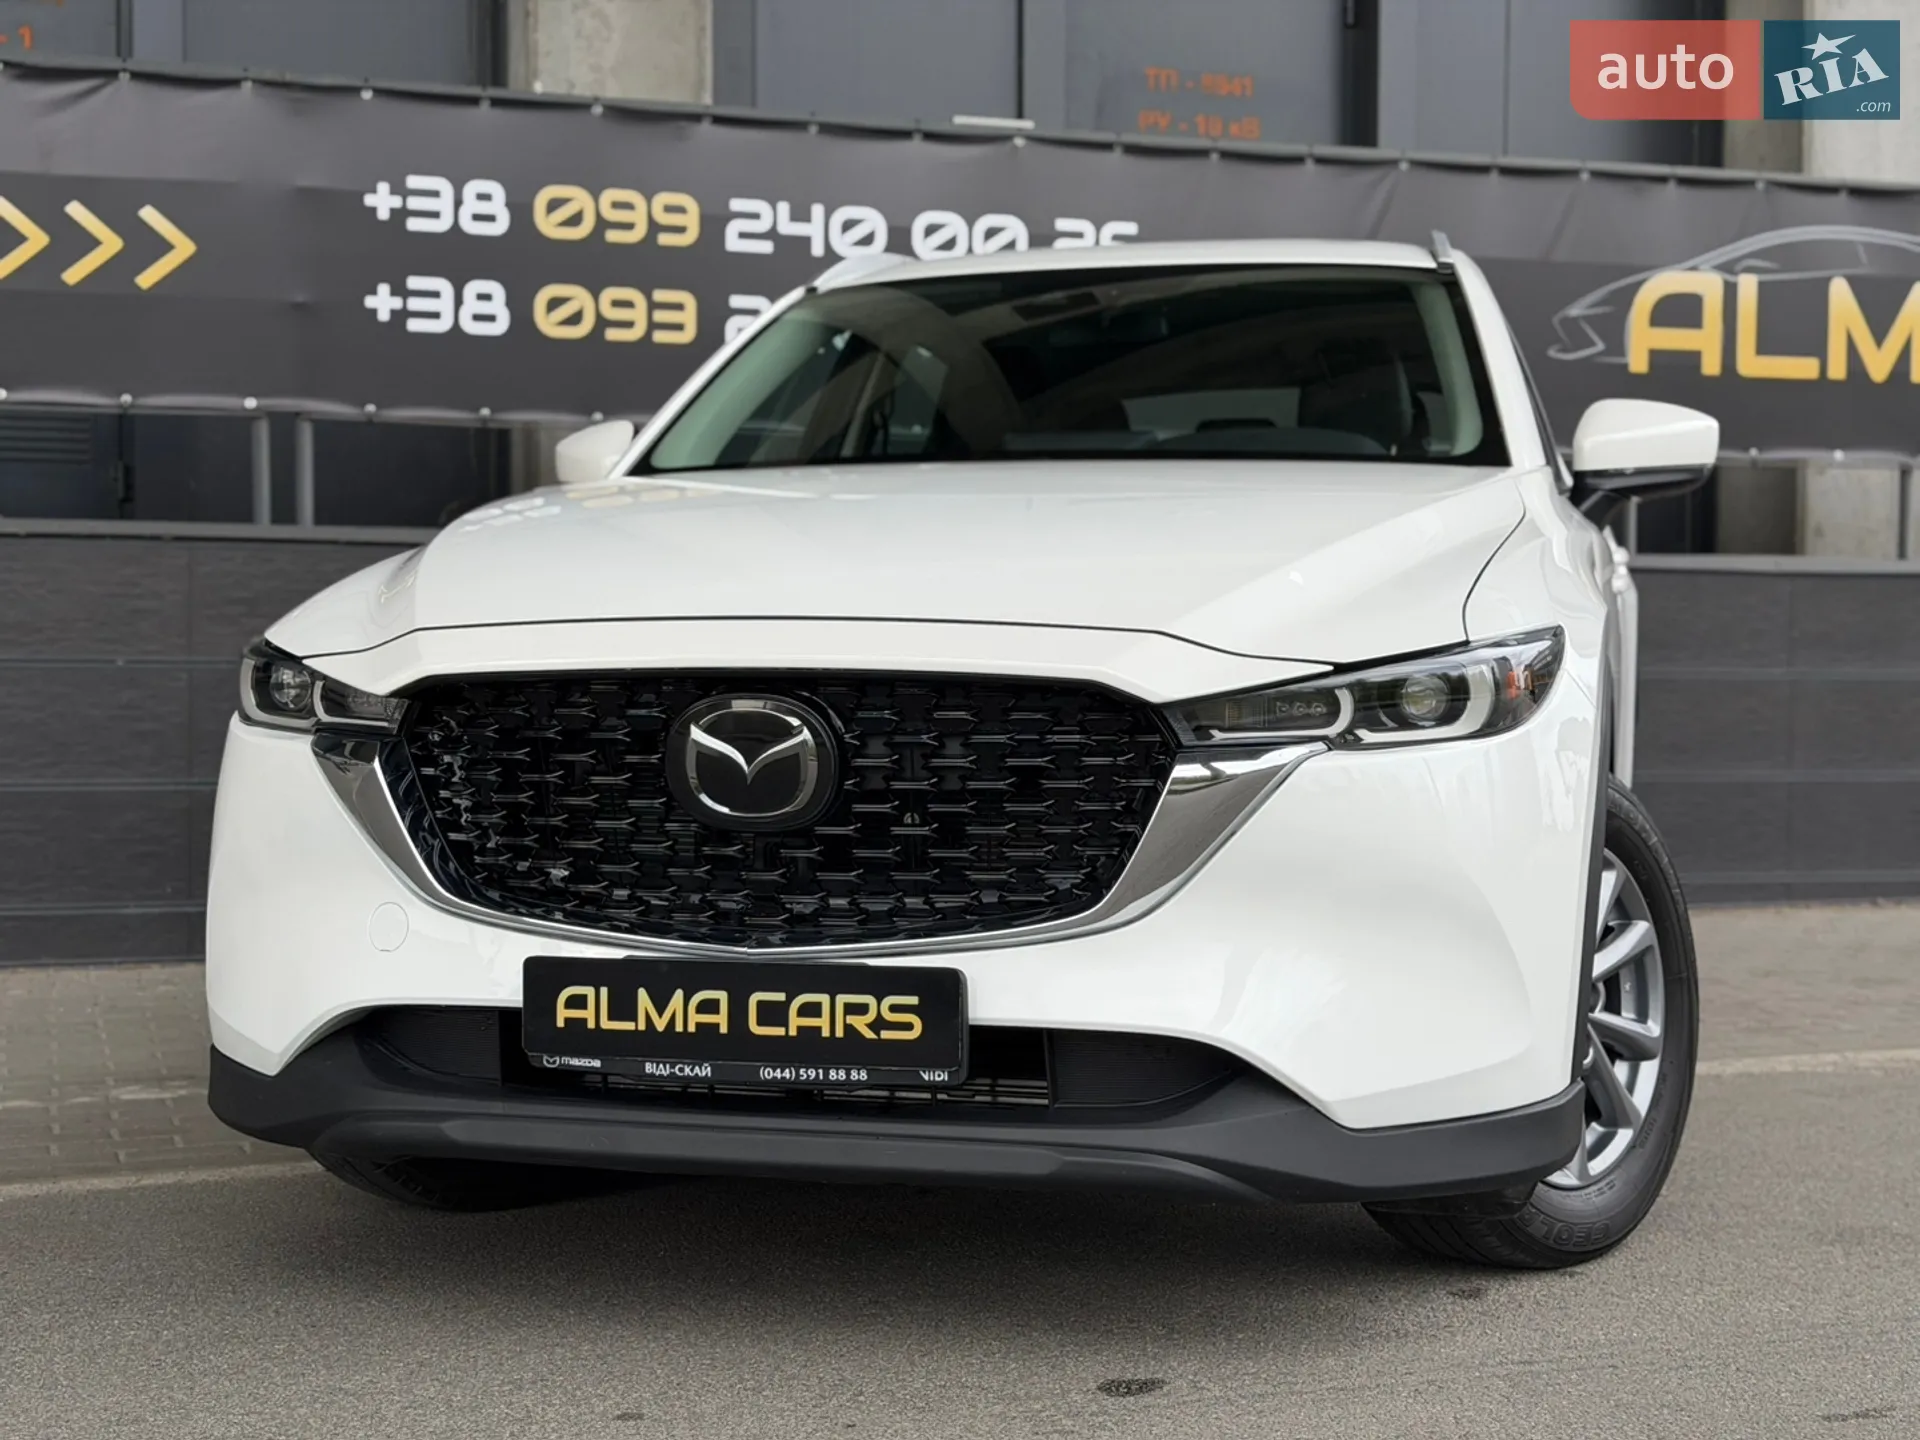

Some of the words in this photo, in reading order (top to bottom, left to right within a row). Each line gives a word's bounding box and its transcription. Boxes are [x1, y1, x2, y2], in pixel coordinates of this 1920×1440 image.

[363, 174, 511, 236] +38
[533, 184, 701, 248] 099
[725, 197, 888, 258] 240
[363, 275, 511, 336] +38
[533, 283, 698, 345] 093
[556, 985, 729, 1034] ALMA
[748, 991, 923, 1040] CARS
[759, 1066, 796, 1081] (044)
[799, 1068, 824, 1081] 591
[829, 1068, 847, 1081] 88
[850, 1069, 868, 1082] 88
